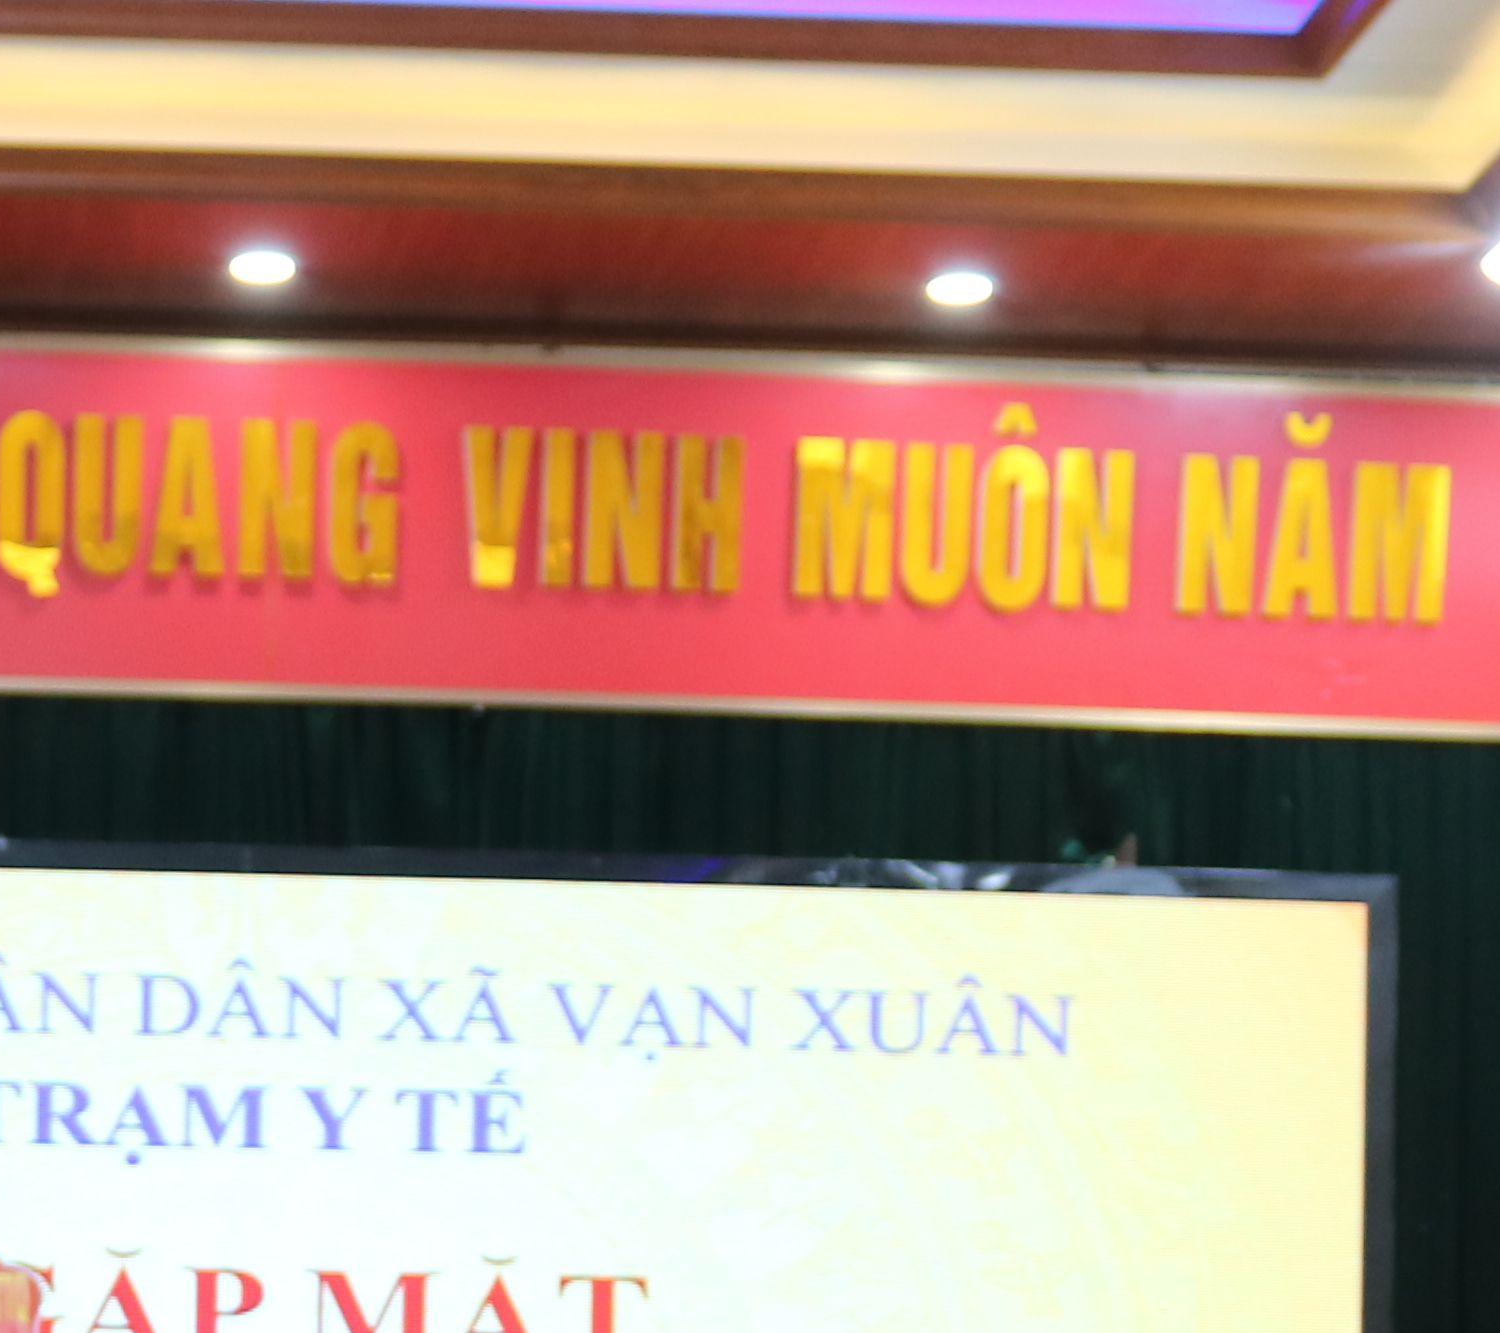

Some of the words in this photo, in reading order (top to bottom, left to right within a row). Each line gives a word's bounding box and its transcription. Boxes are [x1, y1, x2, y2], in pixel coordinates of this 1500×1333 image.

[461, 422, 744, 594] VINH
[793, 402, 1136, 614] MUÔN
[1176, 410, 1454, 625] NĂM
[135, 959, 345, 1039] DÂN
[379, 965, 517, 1045] XÃ
[548, 983, 757, 1061] VẠN
[791, 974, 1073, 1056] XUÂN
[300, 1086, 368, 1152] Y
[395, 1068, 526, 1155] TẾ
